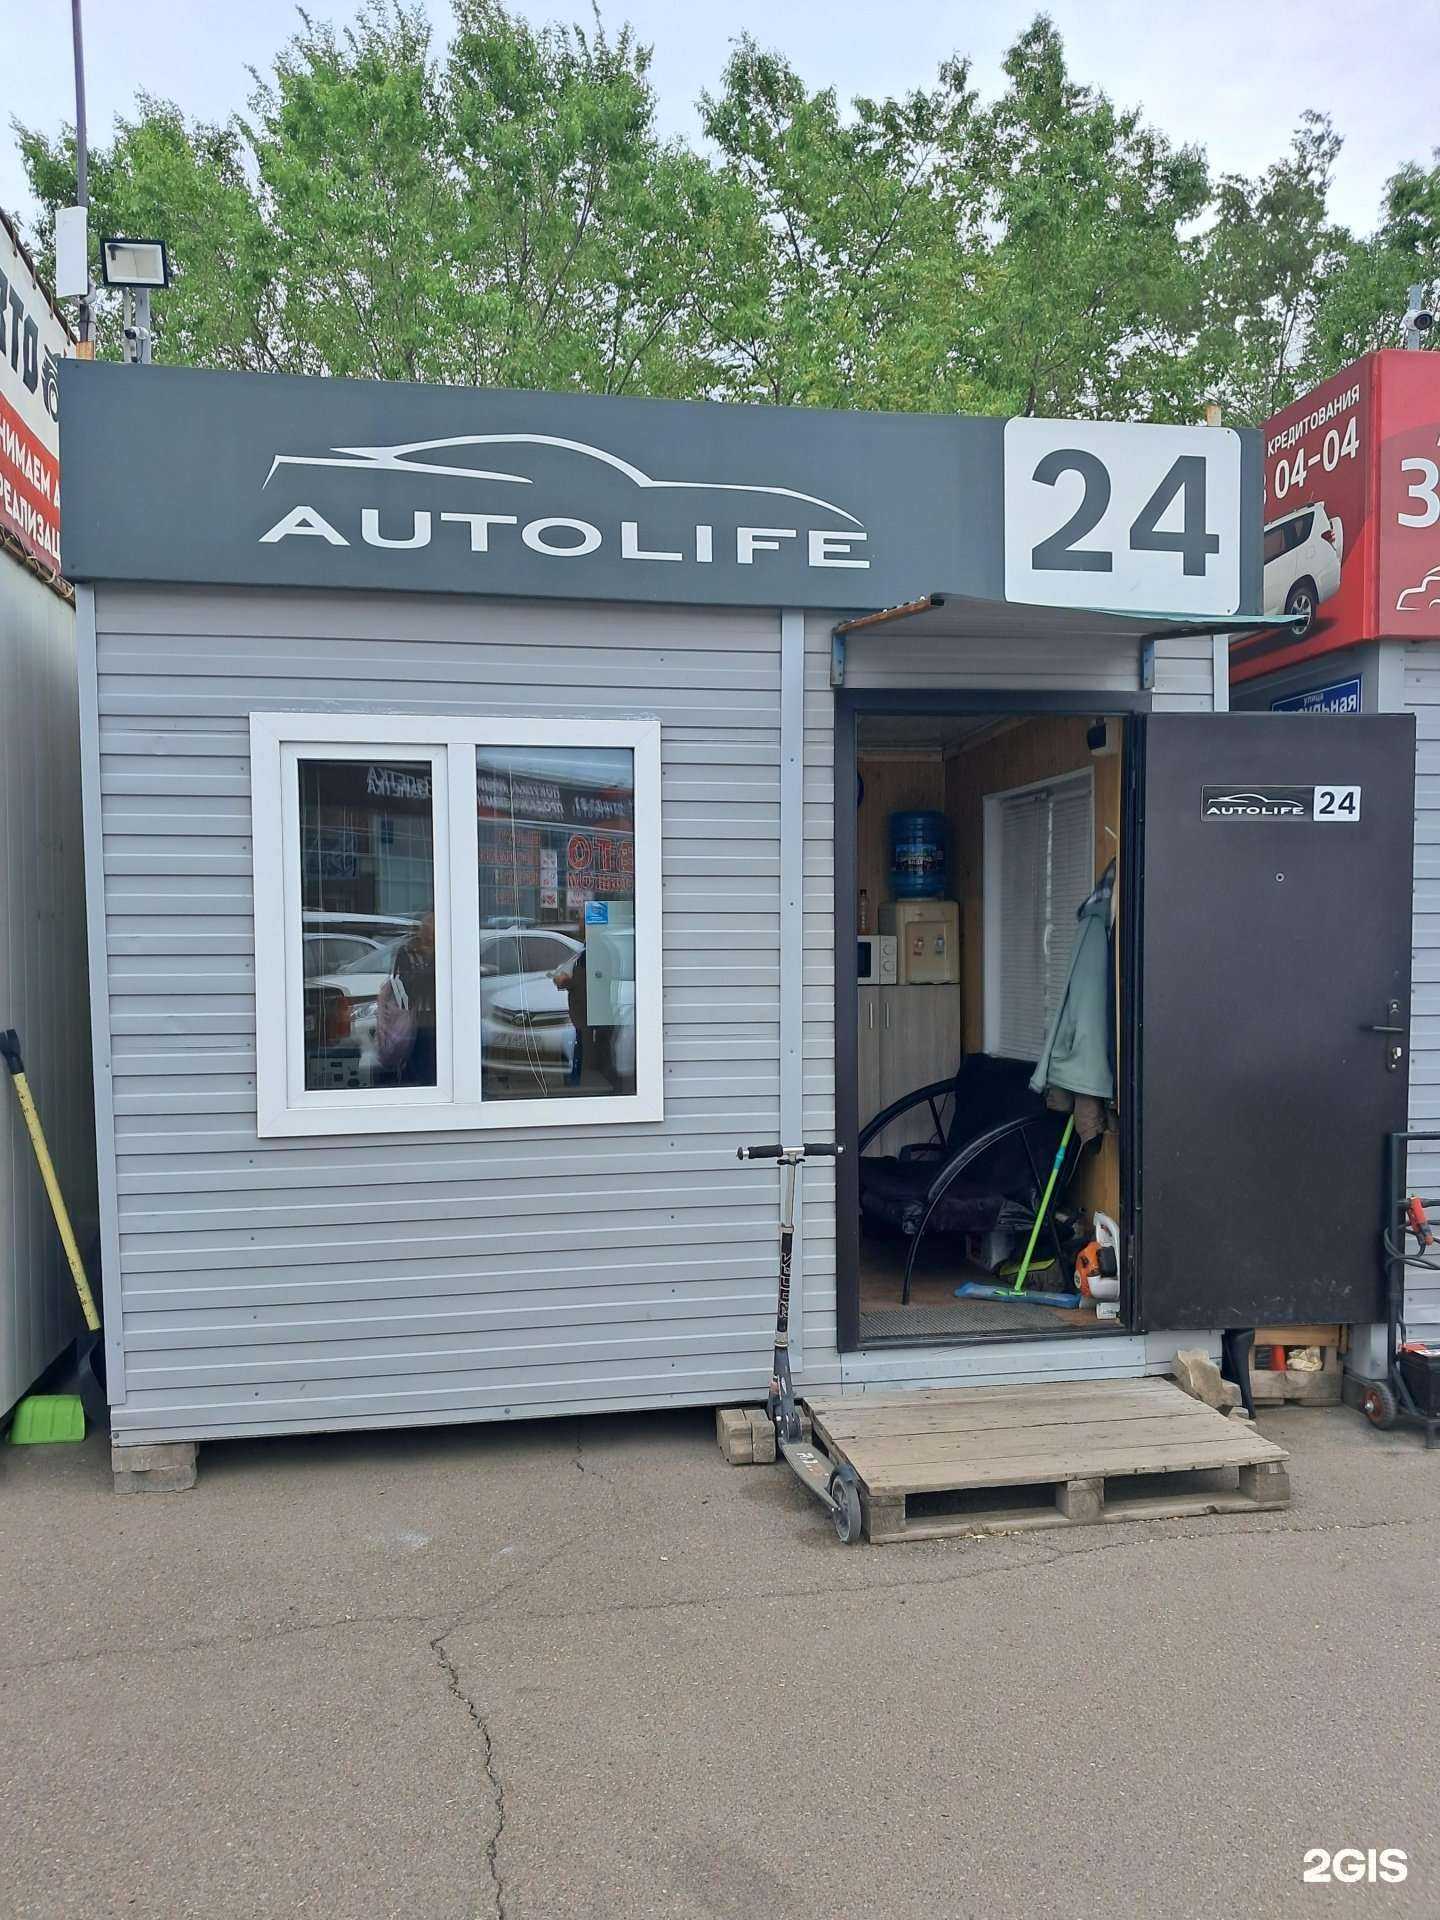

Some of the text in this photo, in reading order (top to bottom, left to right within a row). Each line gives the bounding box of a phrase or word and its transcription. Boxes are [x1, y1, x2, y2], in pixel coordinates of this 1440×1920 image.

[1267, 384, 1360, 457] КРЕДИТОВАНИЯ
[258, 449, 1220, 577] AUTOLIFE 24
[1304, 692, 1324, 706] улица
[1206, 791, 1356, 815] AUTOLIFE 24
